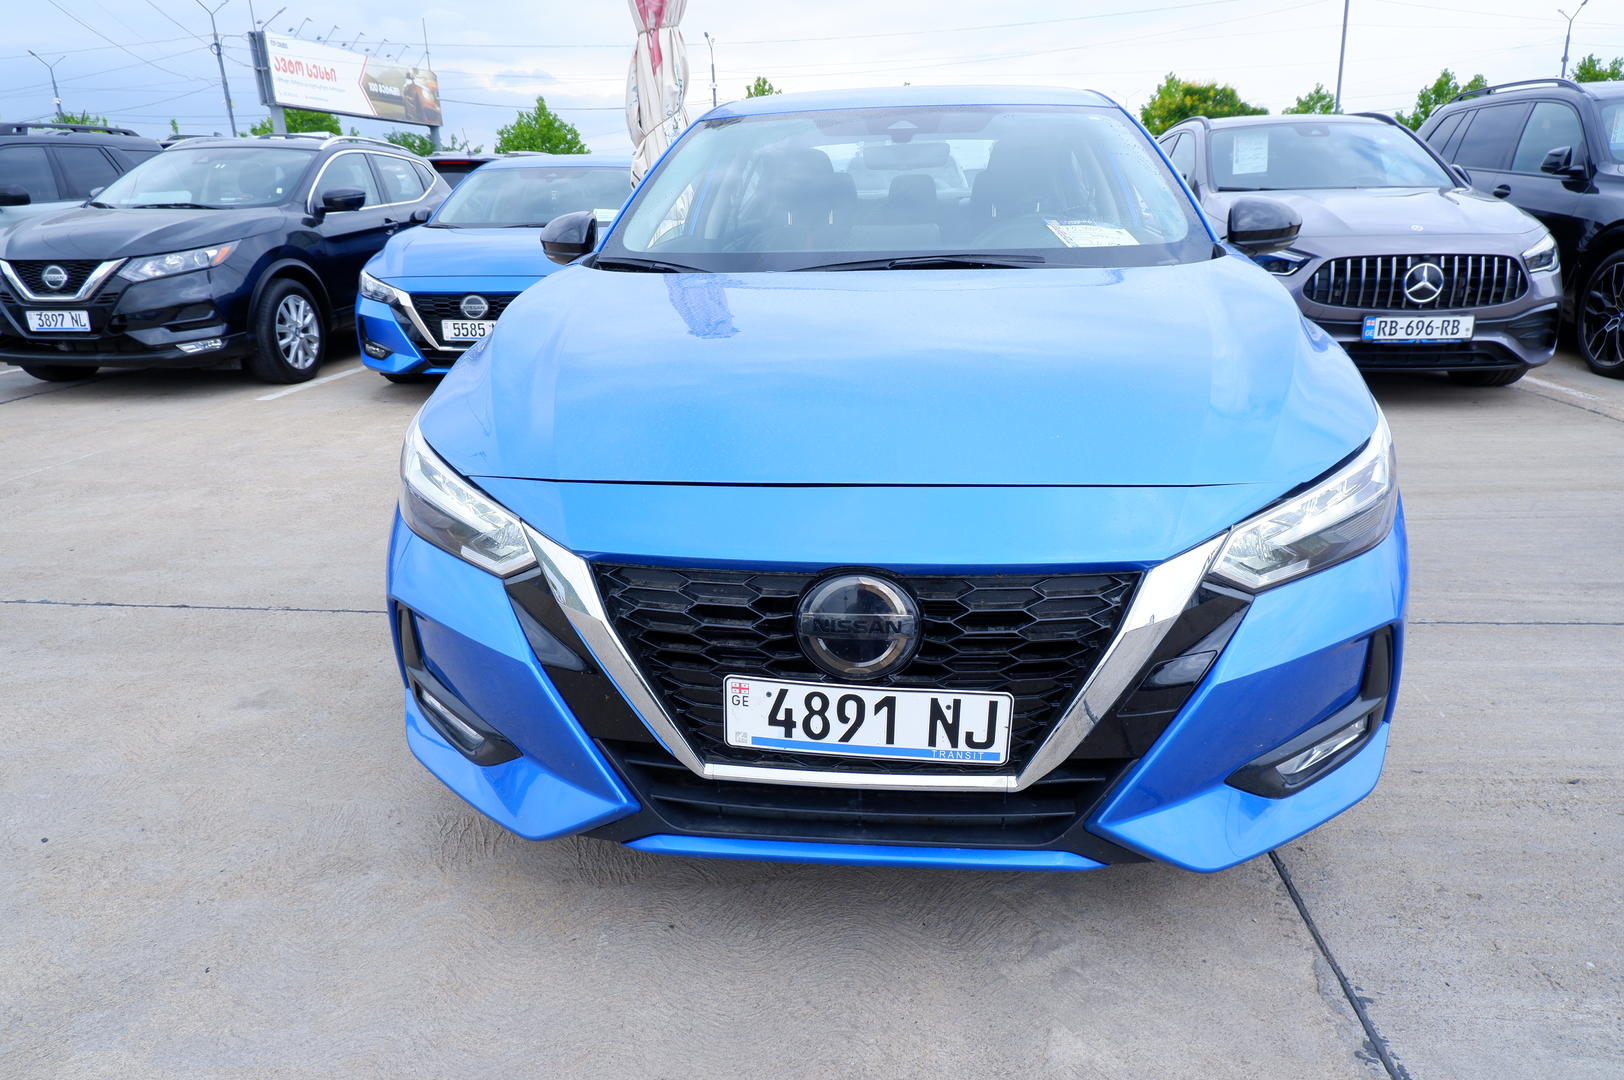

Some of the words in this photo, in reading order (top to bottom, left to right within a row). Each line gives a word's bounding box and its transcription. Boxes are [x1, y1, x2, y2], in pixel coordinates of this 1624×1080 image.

[36, 311, 65, 327] 3897
[69, 312, 87, 327] NL
[452, 322, 486, 337] 5585
[1377, 319, 1460, 336] RB-696-RB
[813, 618, 901, 634] NISSAN
[731, 694, 750, 707] GE
[767, 688, 897, 745] 4891
[927, 697, 999, 749] NJ
[931, 749, 985, 761] TRANSIT
